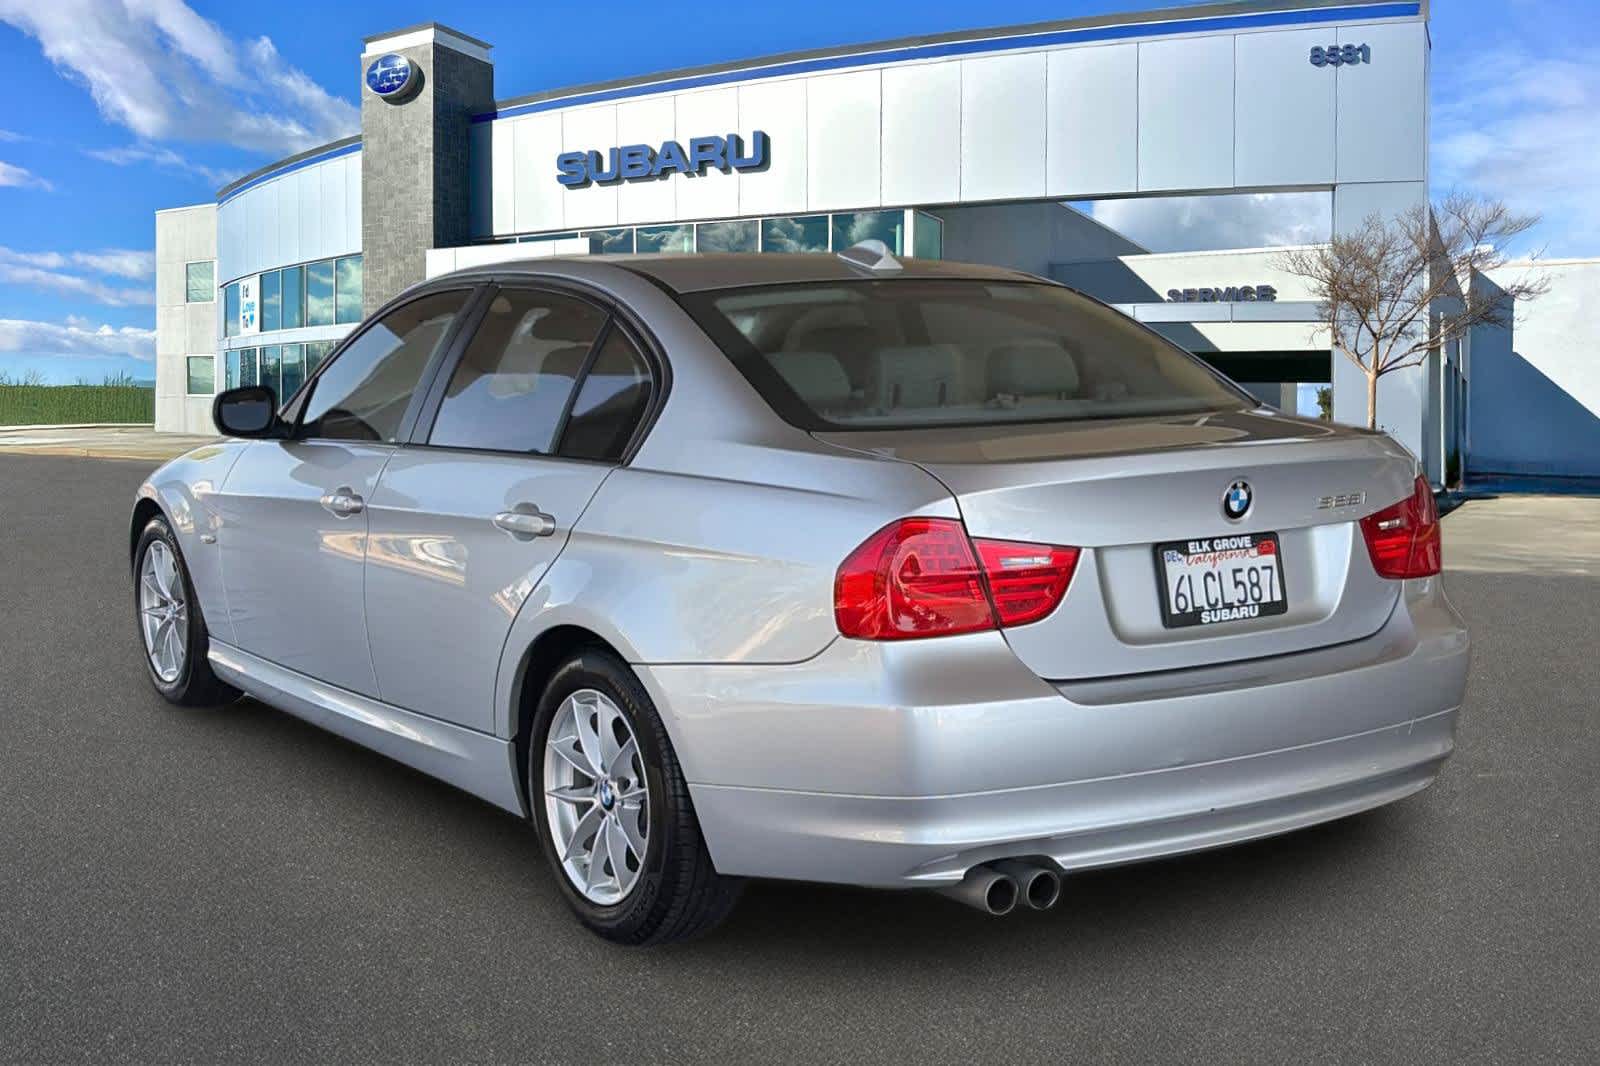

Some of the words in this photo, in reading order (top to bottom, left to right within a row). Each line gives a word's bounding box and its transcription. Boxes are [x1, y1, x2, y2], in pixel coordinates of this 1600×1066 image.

[556, 130, 771, 190] SUBARU
[1167, 284, 1277, 303] SERVICE
[1188, 541, 1211, 554] ELK
[1213, 536, 1252, 551] GROVE
[1174, 565, 1275, 614] 6LCL587
[1200, 605, 1259, 624] SUBARU
